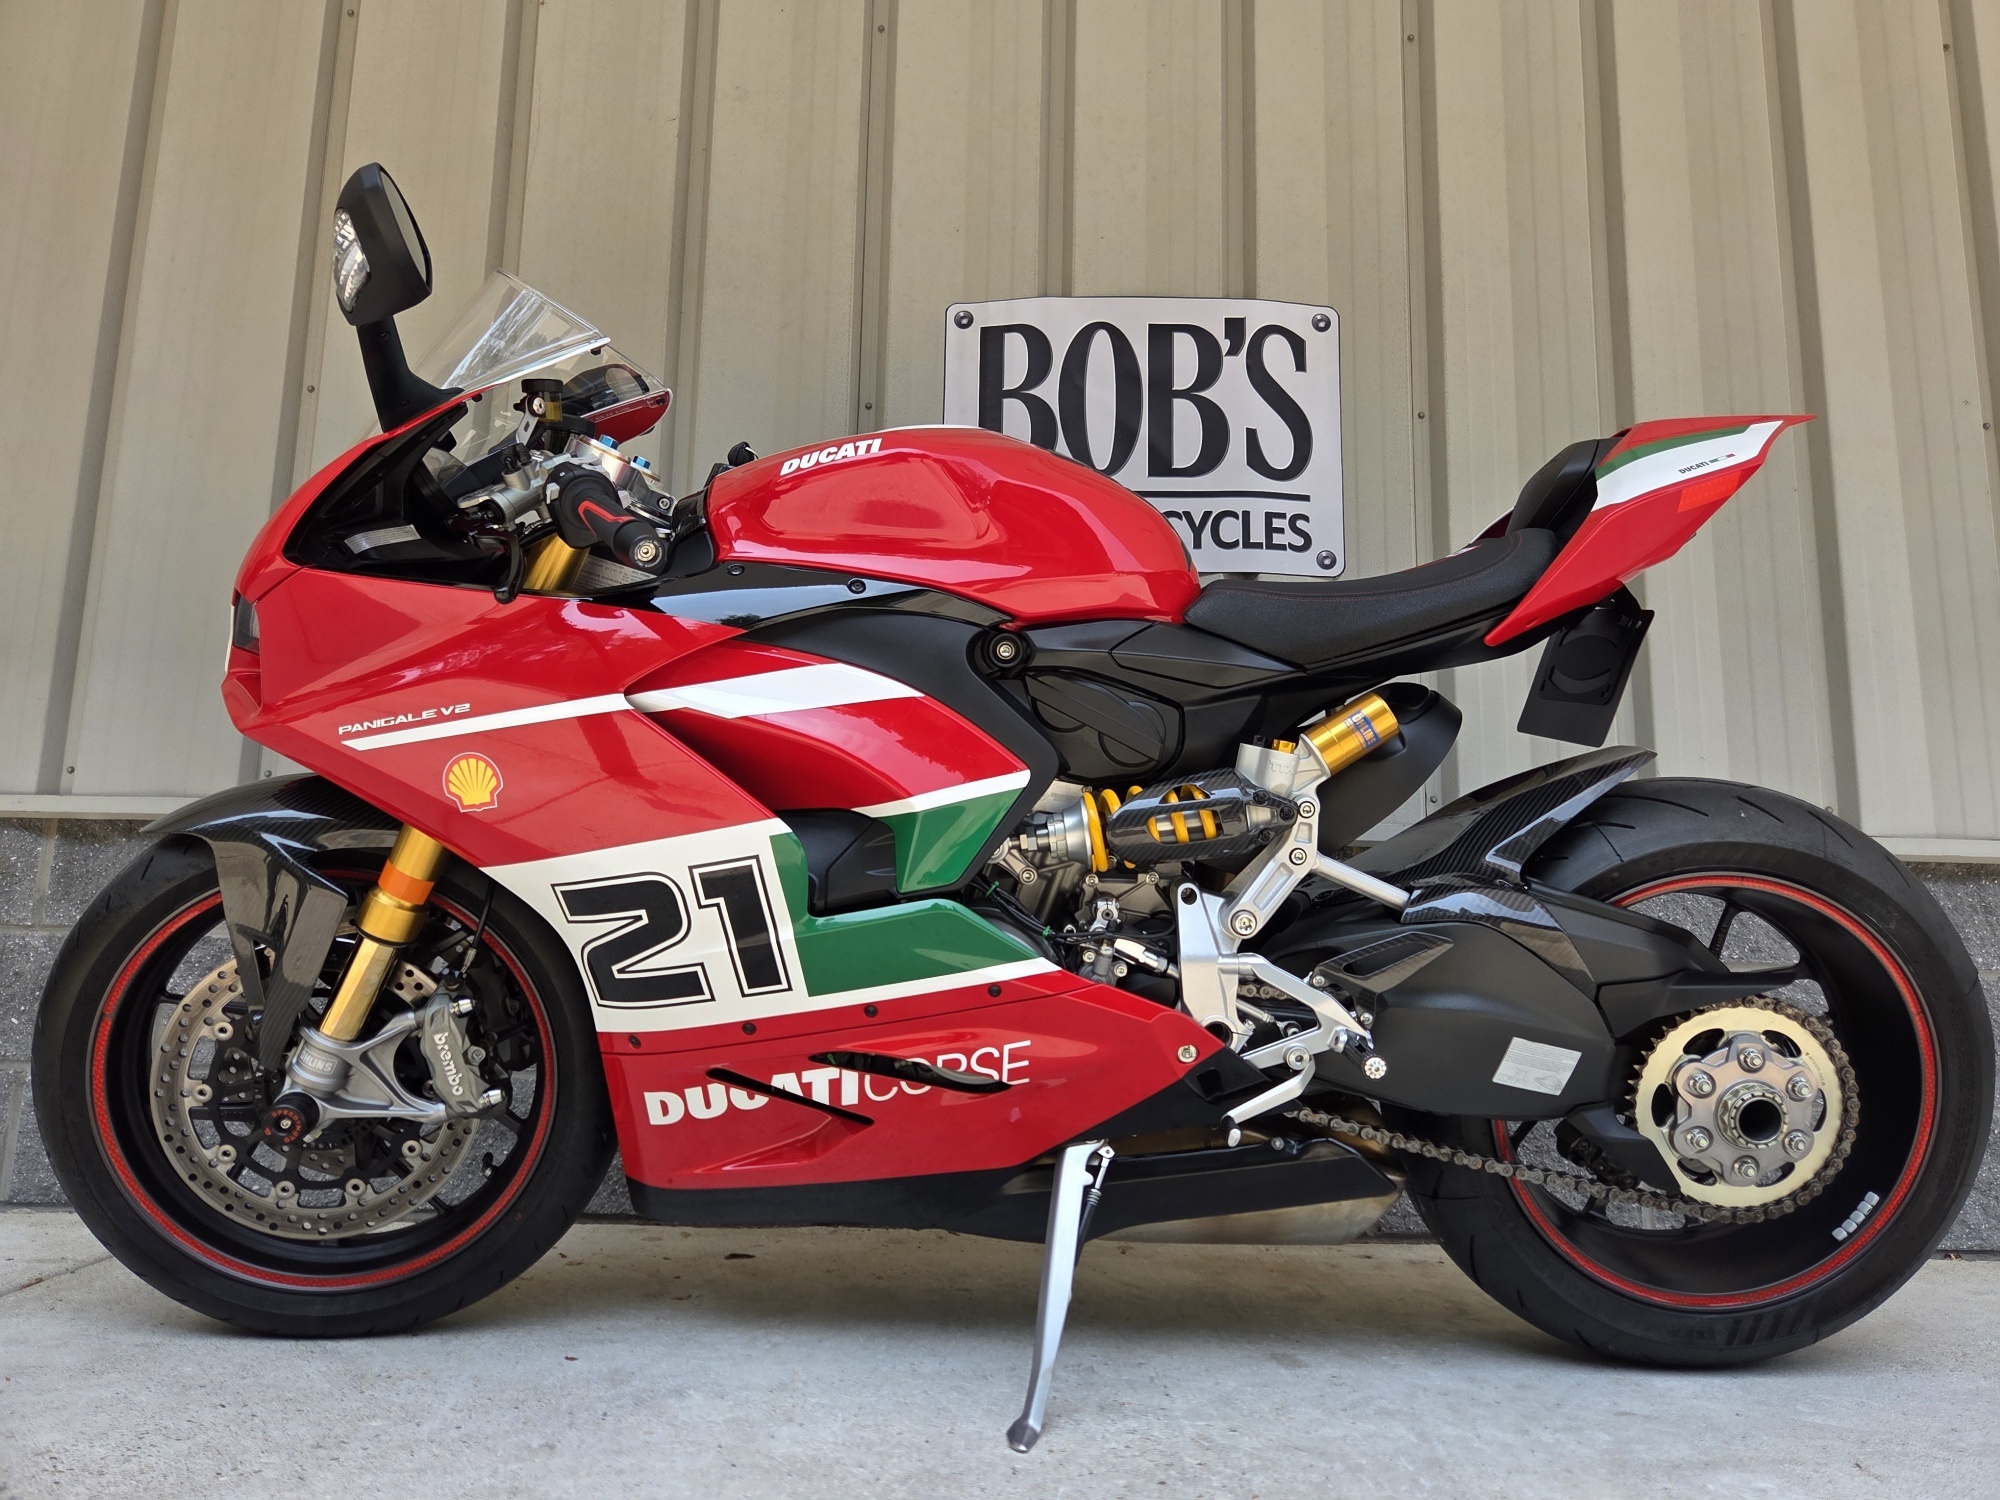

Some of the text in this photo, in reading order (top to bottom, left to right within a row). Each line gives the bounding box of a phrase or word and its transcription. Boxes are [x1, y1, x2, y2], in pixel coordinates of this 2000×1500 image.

[978, 317, 1313, 482] BOB'S
[780, 438, 882, 476] DUCATI
[1678, 461, 1710, 474] DUCATI
[338, 703, 471, 735] PANIGALE V2
[550, 854, 793, 1010] 21
[433, 1032, 463, 1096] brembo
